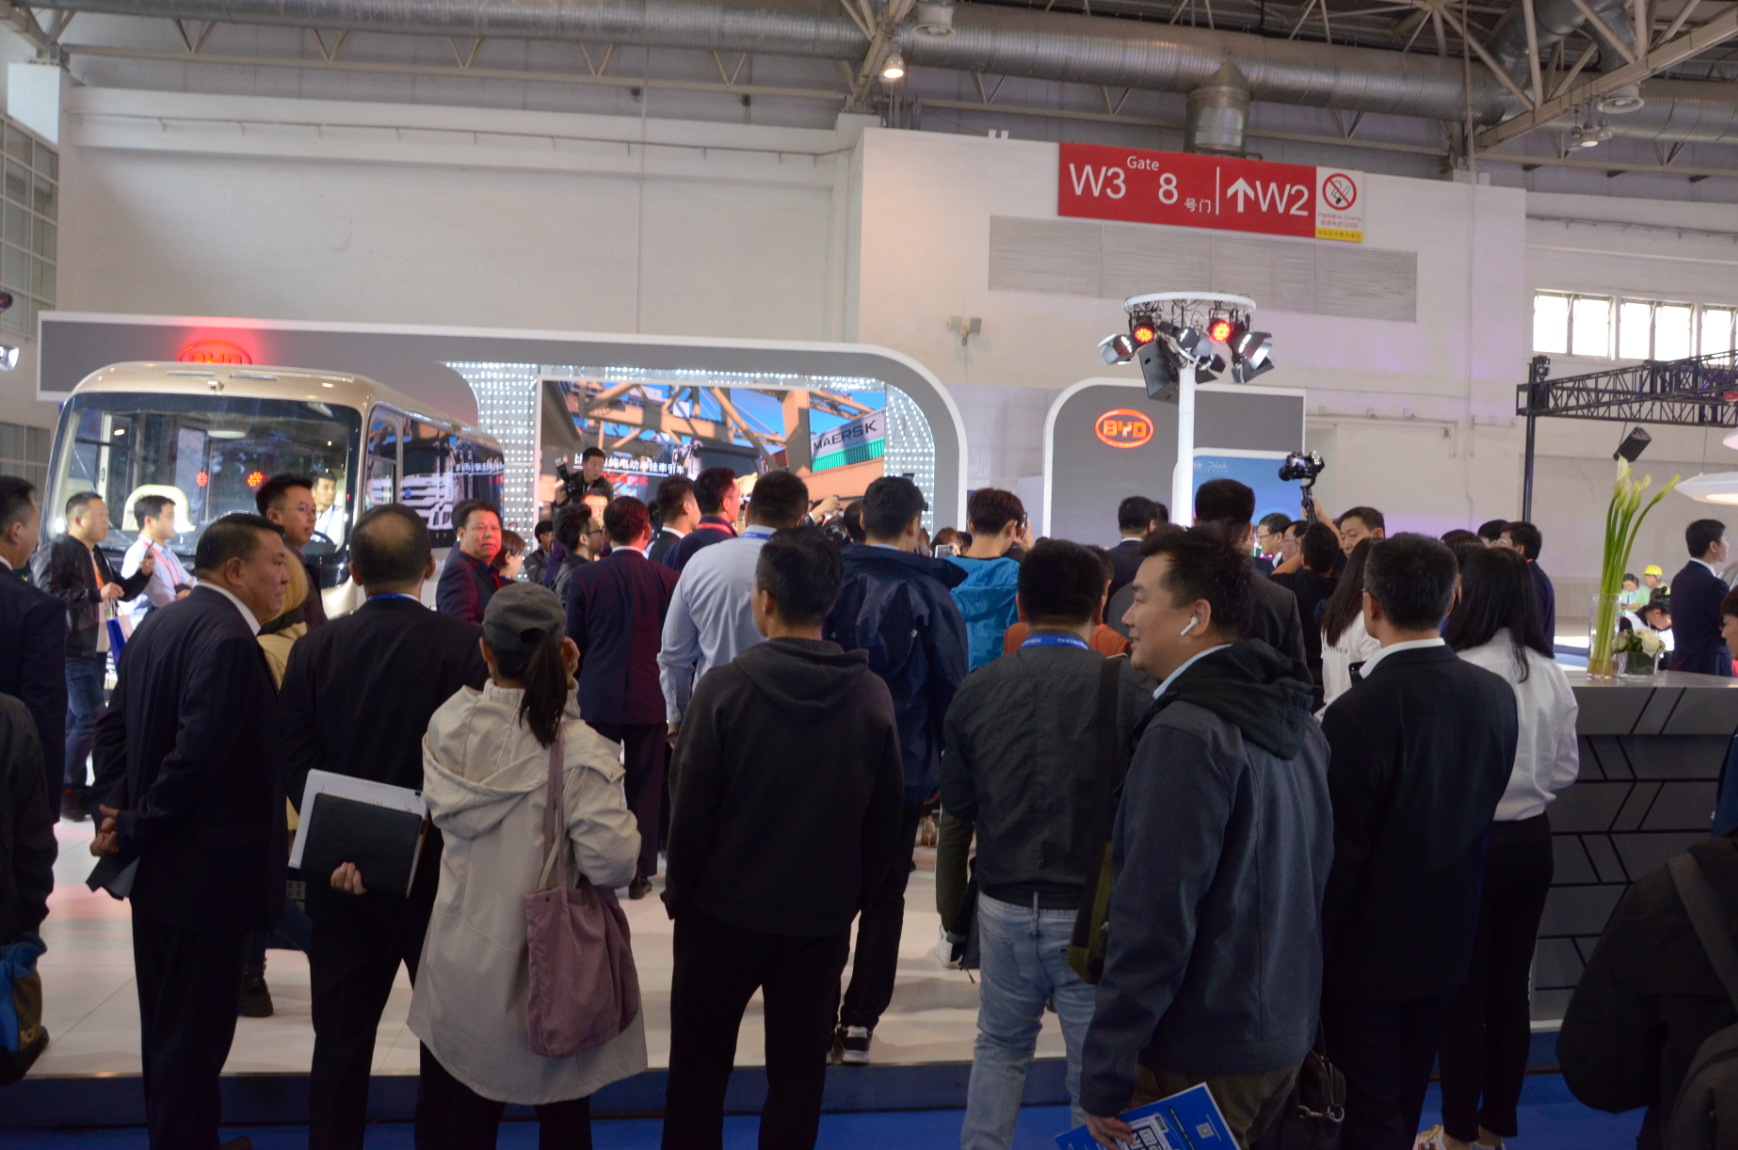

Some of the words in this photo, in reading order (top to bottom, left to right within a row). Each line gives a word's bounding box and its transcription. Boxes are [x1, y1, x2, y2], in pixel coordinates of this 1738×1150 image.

[1127, 155, 1160, 171] Gate
[1069, 163, 1126, 200] W3
[1158, 172, 1179, 205] 8
[1184, 197, 1211, 214] 号门
[1255, 180, 1309, 216] W2
[813, 420, 877, 450] MAERSK
[1103, 419, 1147, 438] BYD
